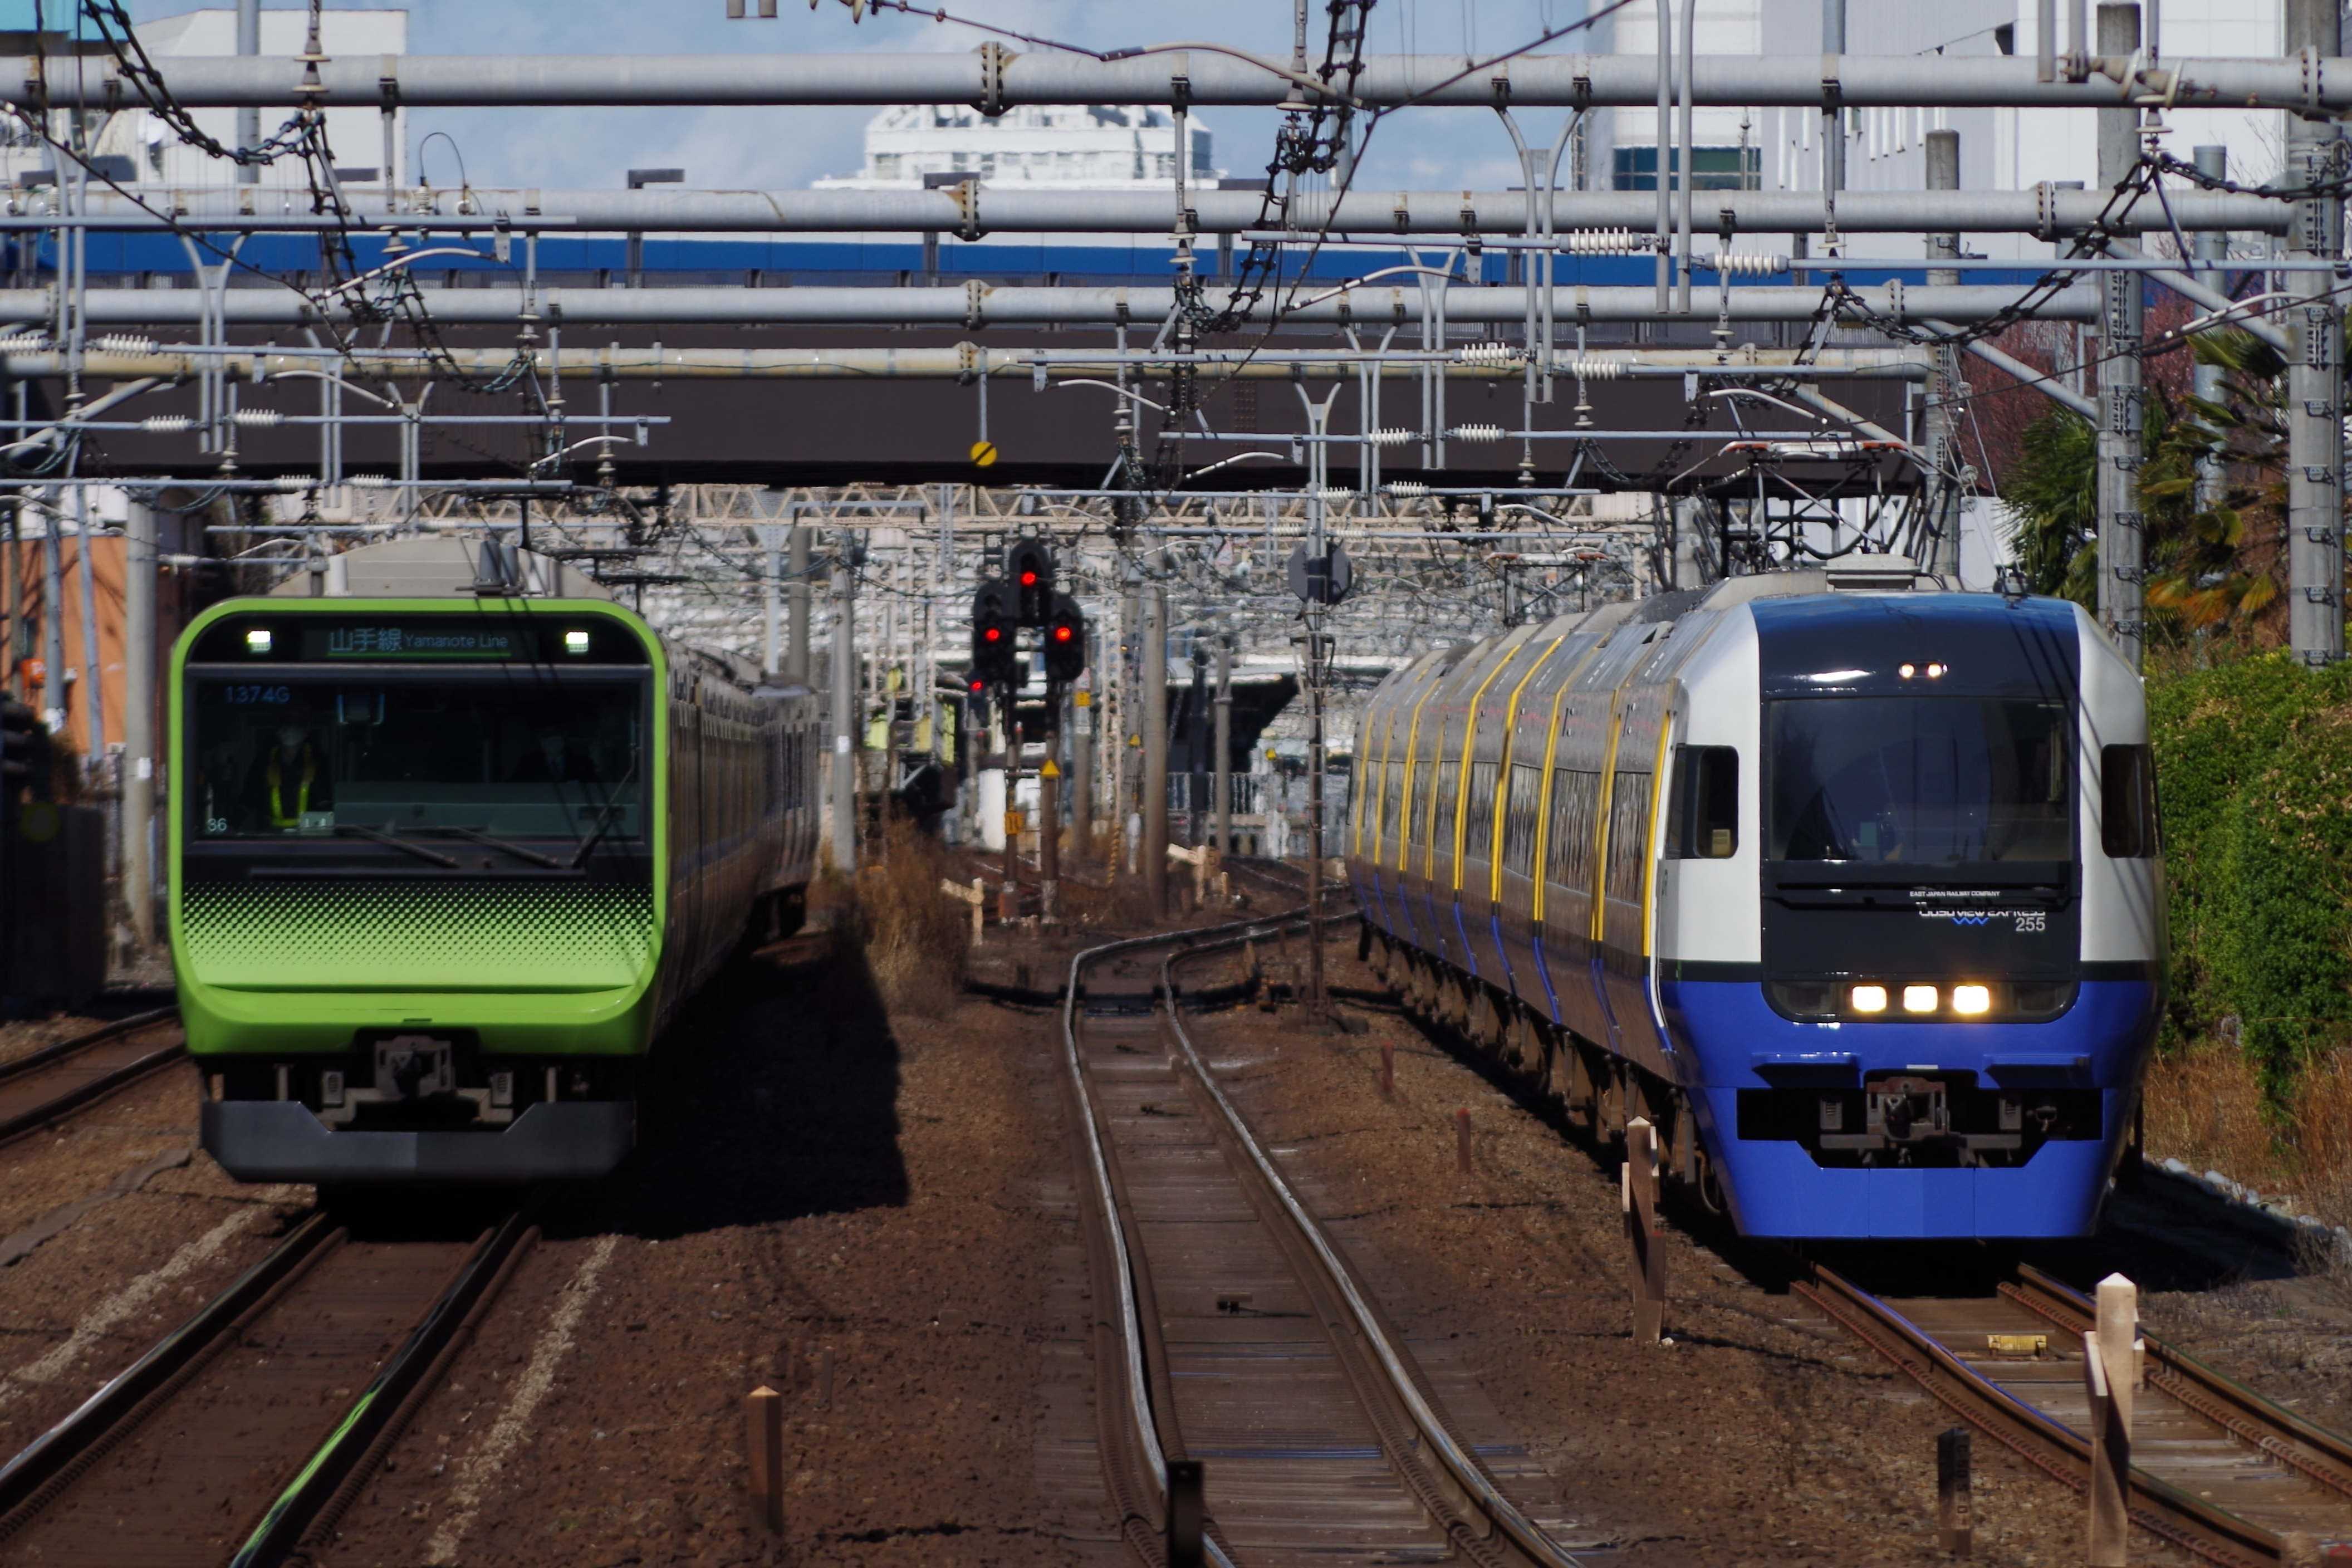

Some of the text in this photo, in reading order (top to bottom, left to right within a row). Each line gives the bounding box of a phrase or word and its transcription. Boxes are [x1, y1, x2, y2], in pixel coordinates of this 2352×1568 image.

[329, 628, 508, 651] 山手線 Yamanote Line
[227, 685, 290, 703] 1374G
[2016, 917, 2046, 932] 255
